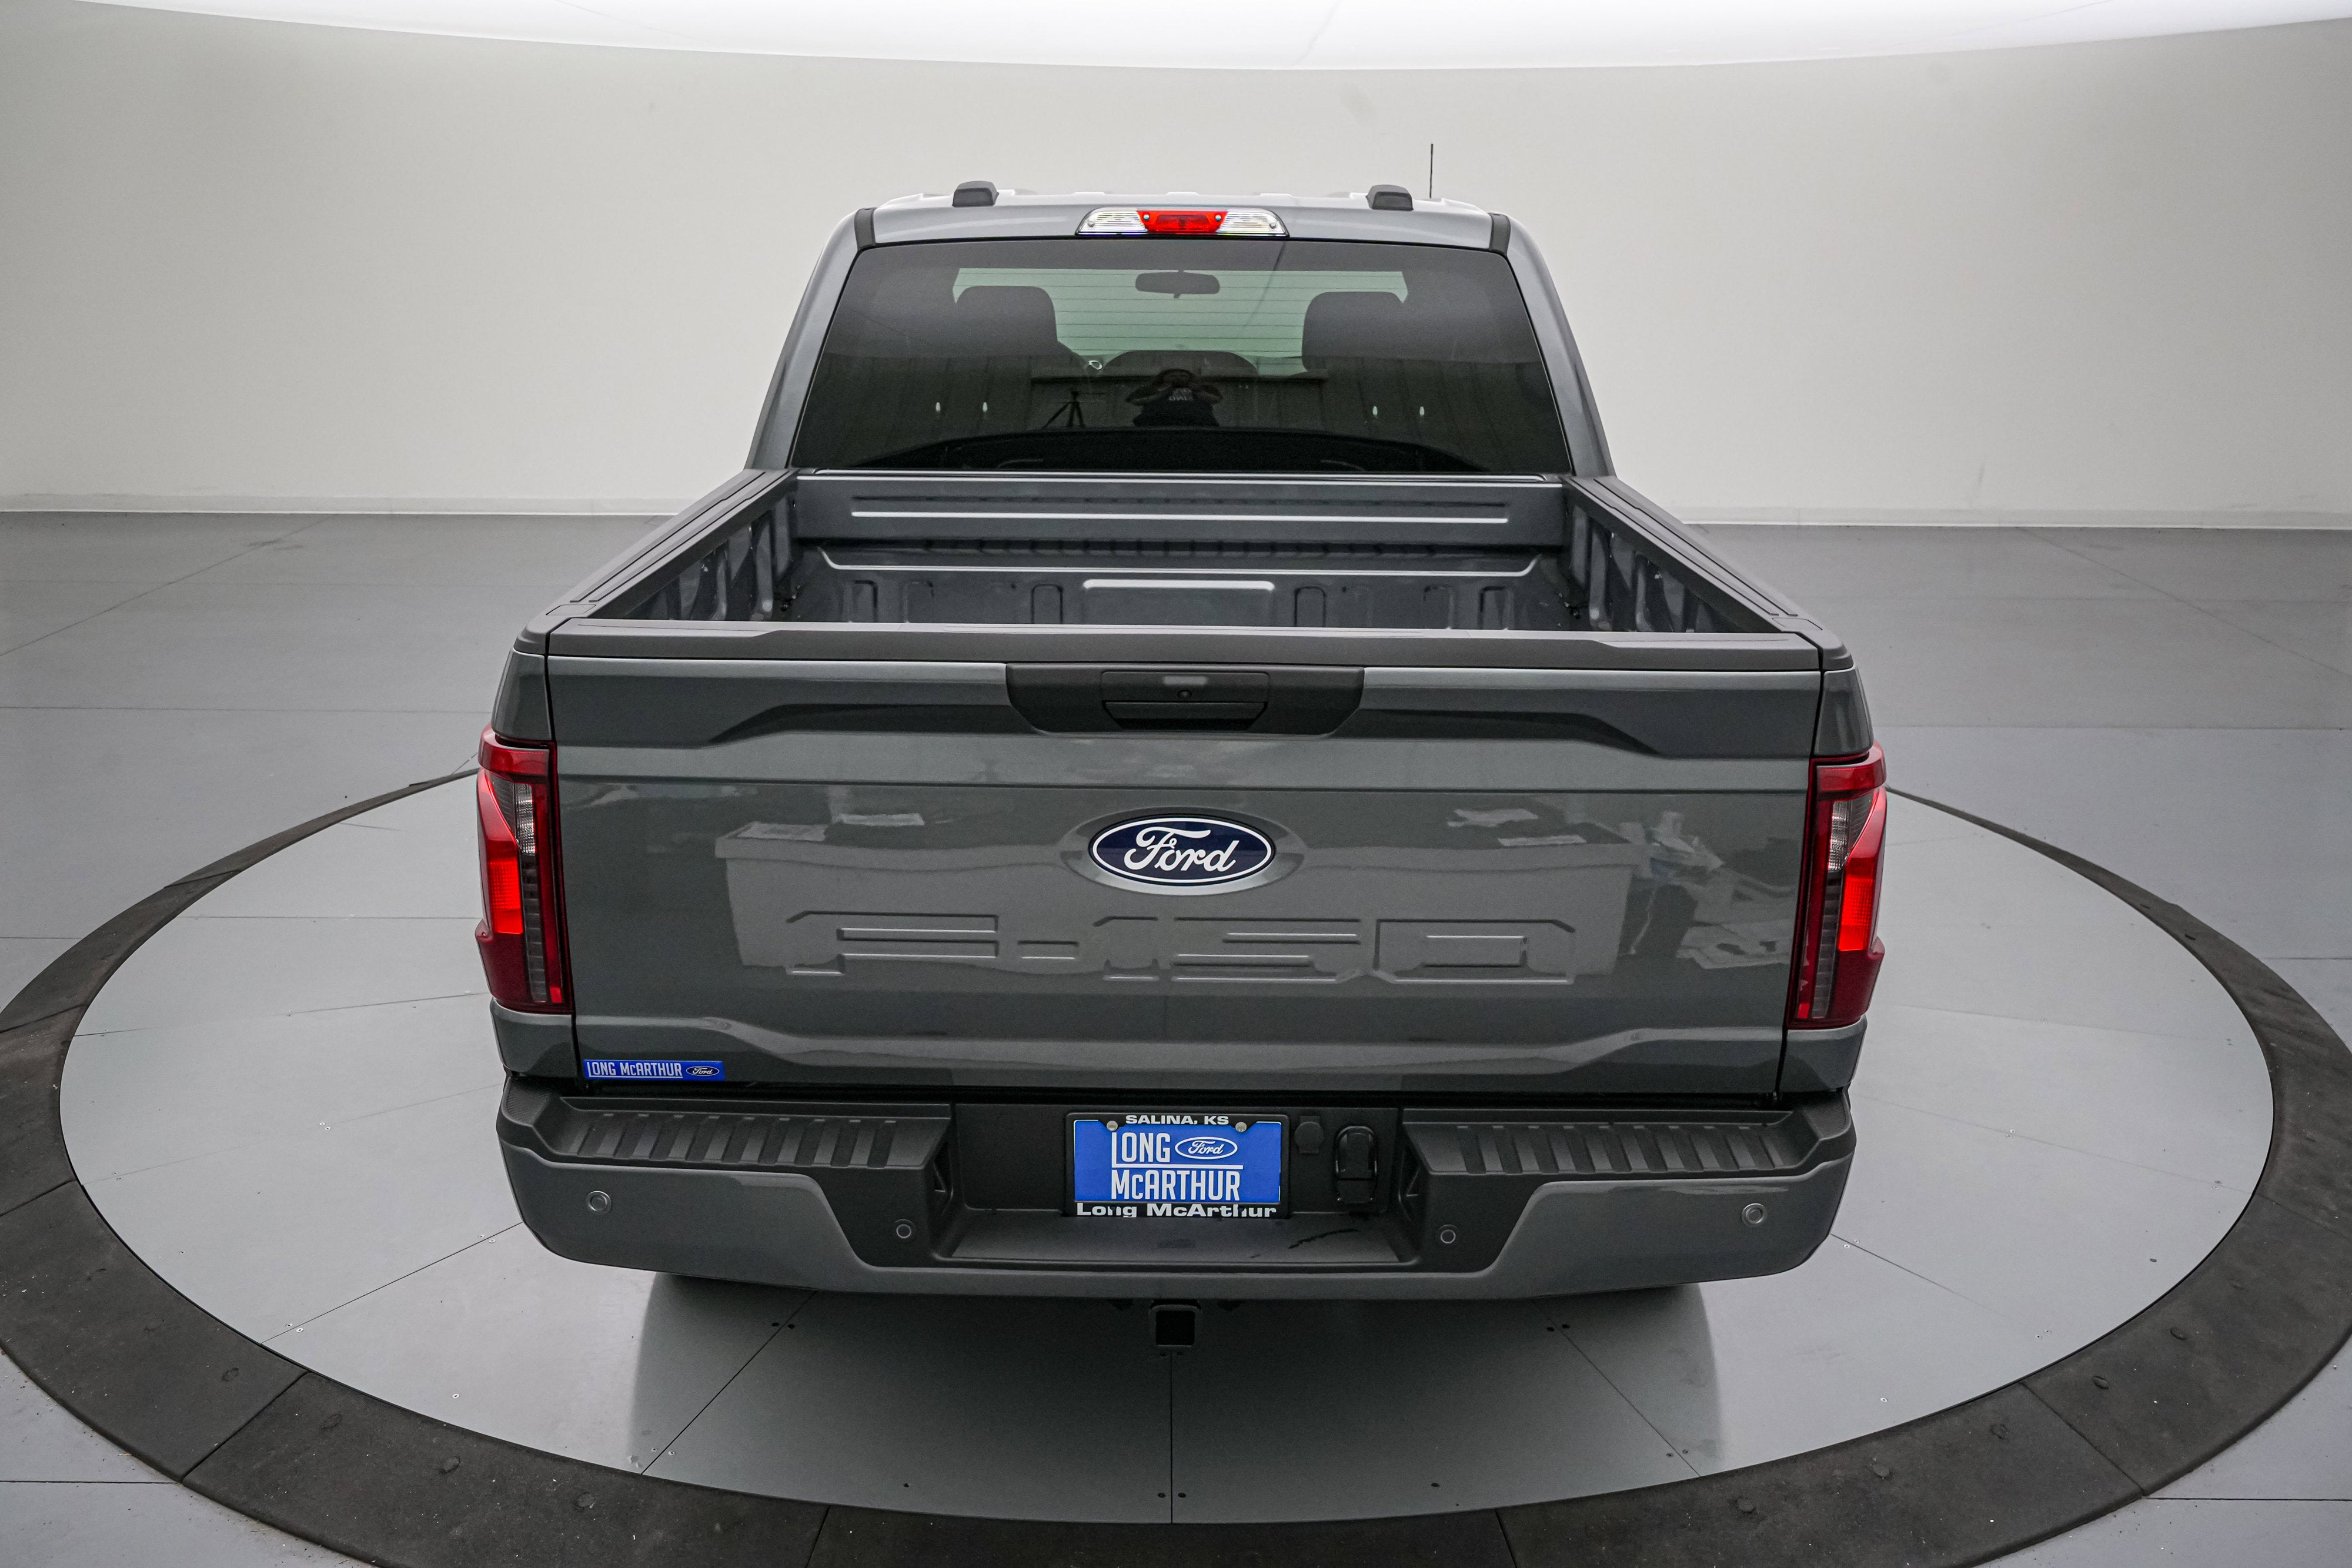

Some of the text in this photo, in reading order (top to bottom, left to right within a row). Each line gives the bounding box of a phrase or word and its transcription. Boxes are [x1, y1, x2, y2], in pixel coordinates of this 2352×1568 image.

[1124, 826, 1240, 872] Ford
[786, 910, 1575, 986] F-150
[587, 1062, 683, 1078] LONG McARTHUR
[692, 1066, 713, 1075] Ford
[1125, 1115, 1230, 1125] SALINA, KS
[1111, 1132, 1171, 1166] LONG
[1188, 1140, 1224, 1155] Ford
[1111, 1169, 1241, 1201] McARTHUR
[1077, 1203, 1277, 1218] Long McArthur
